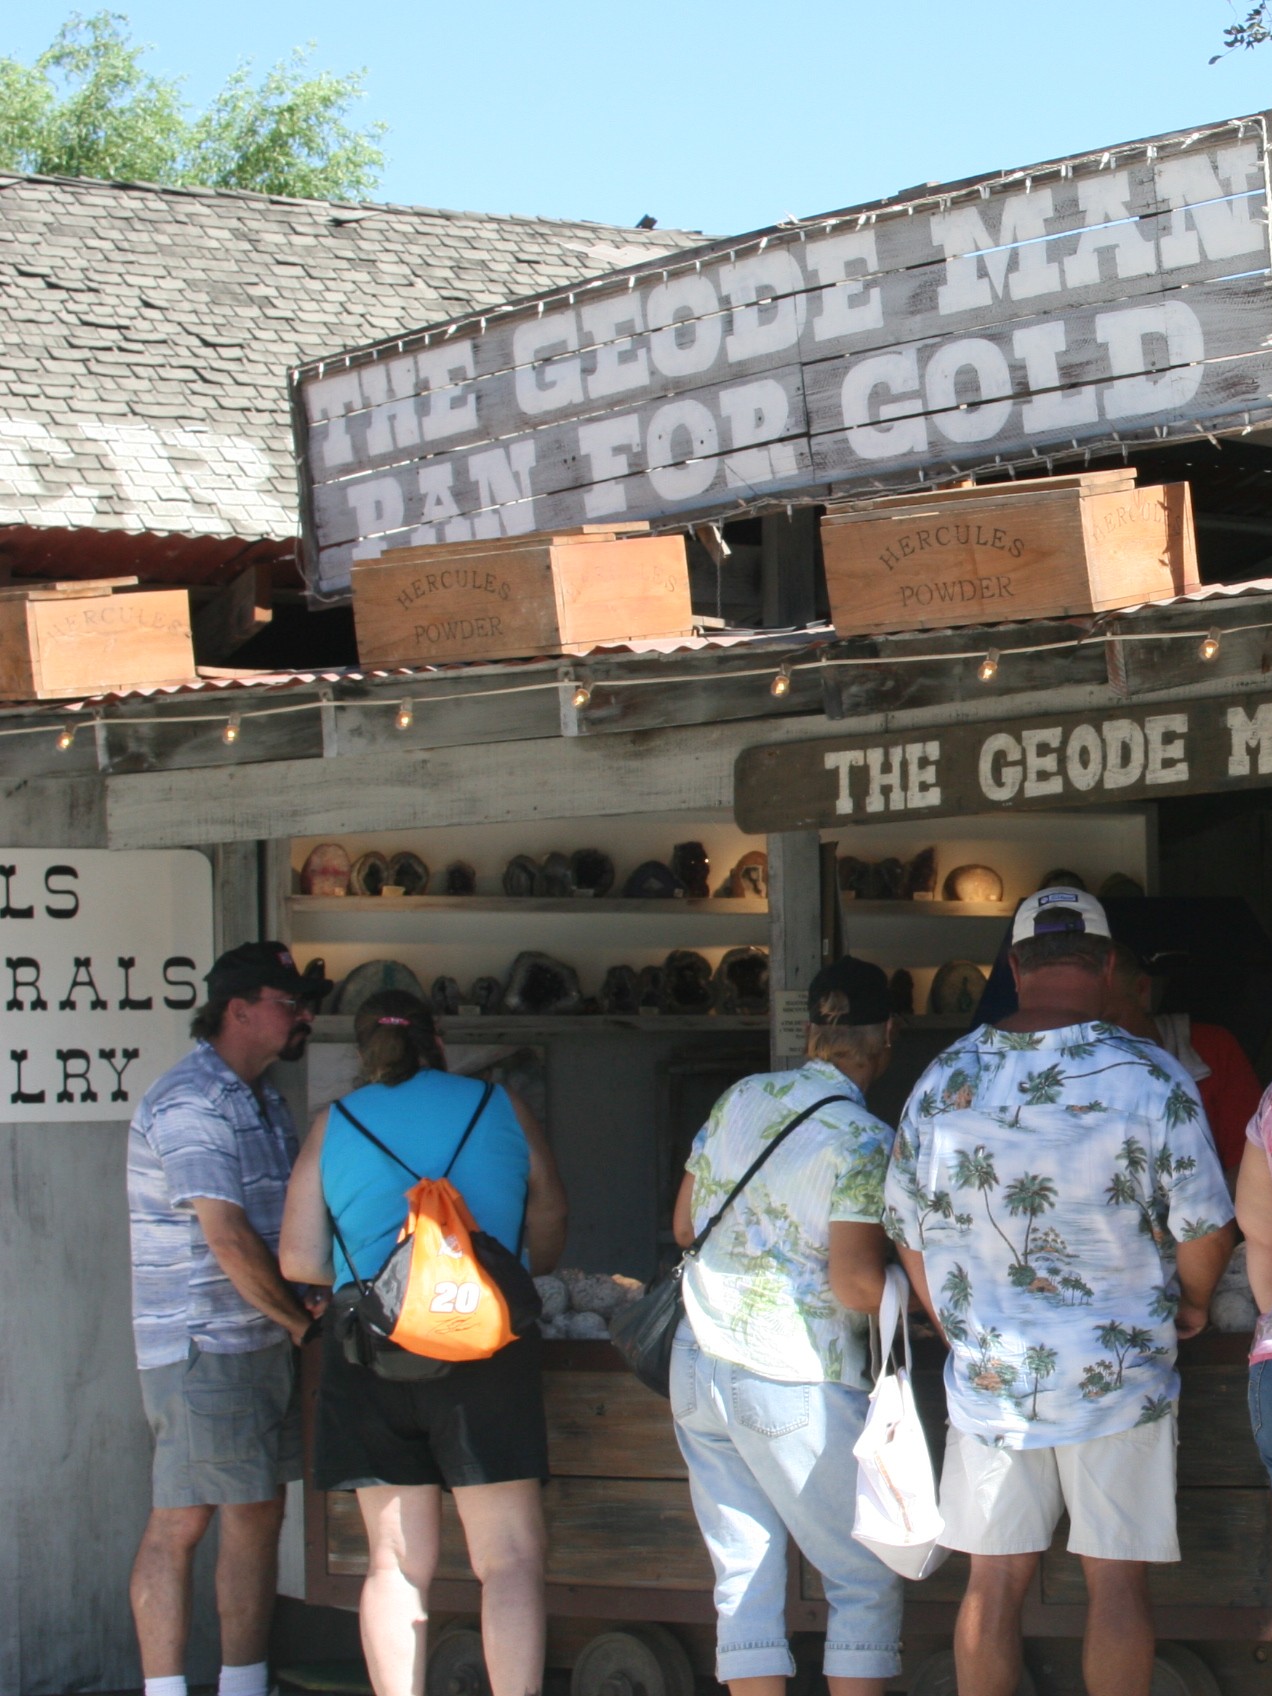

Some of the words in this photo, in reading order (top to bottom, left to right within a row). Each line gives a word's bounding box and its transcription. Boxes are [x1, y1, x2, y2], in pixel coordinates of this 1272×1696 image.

[307, 339, 478, 468] THE
[513, 230, 883, 416] GEODE
[931, 143, 1264, 316] MAN
[347, 439, 536, 560] PAN
[579, 378, 799, 518] FOR
[841, 299, 1205, 460] GOLD
[879, 524, 1025, 572] HERCULES
[397, 569, 512, 611] HERCULES
[899, 575, 1015, 608] POWDER
[414, 615, 504, 646] POWDER
[824, 740, 942, 815] THE
[978, 713, 1189, 802] GEODE
[5, 956, 197, 1011] RALS
[429, 1281, 481, 1315] 20
